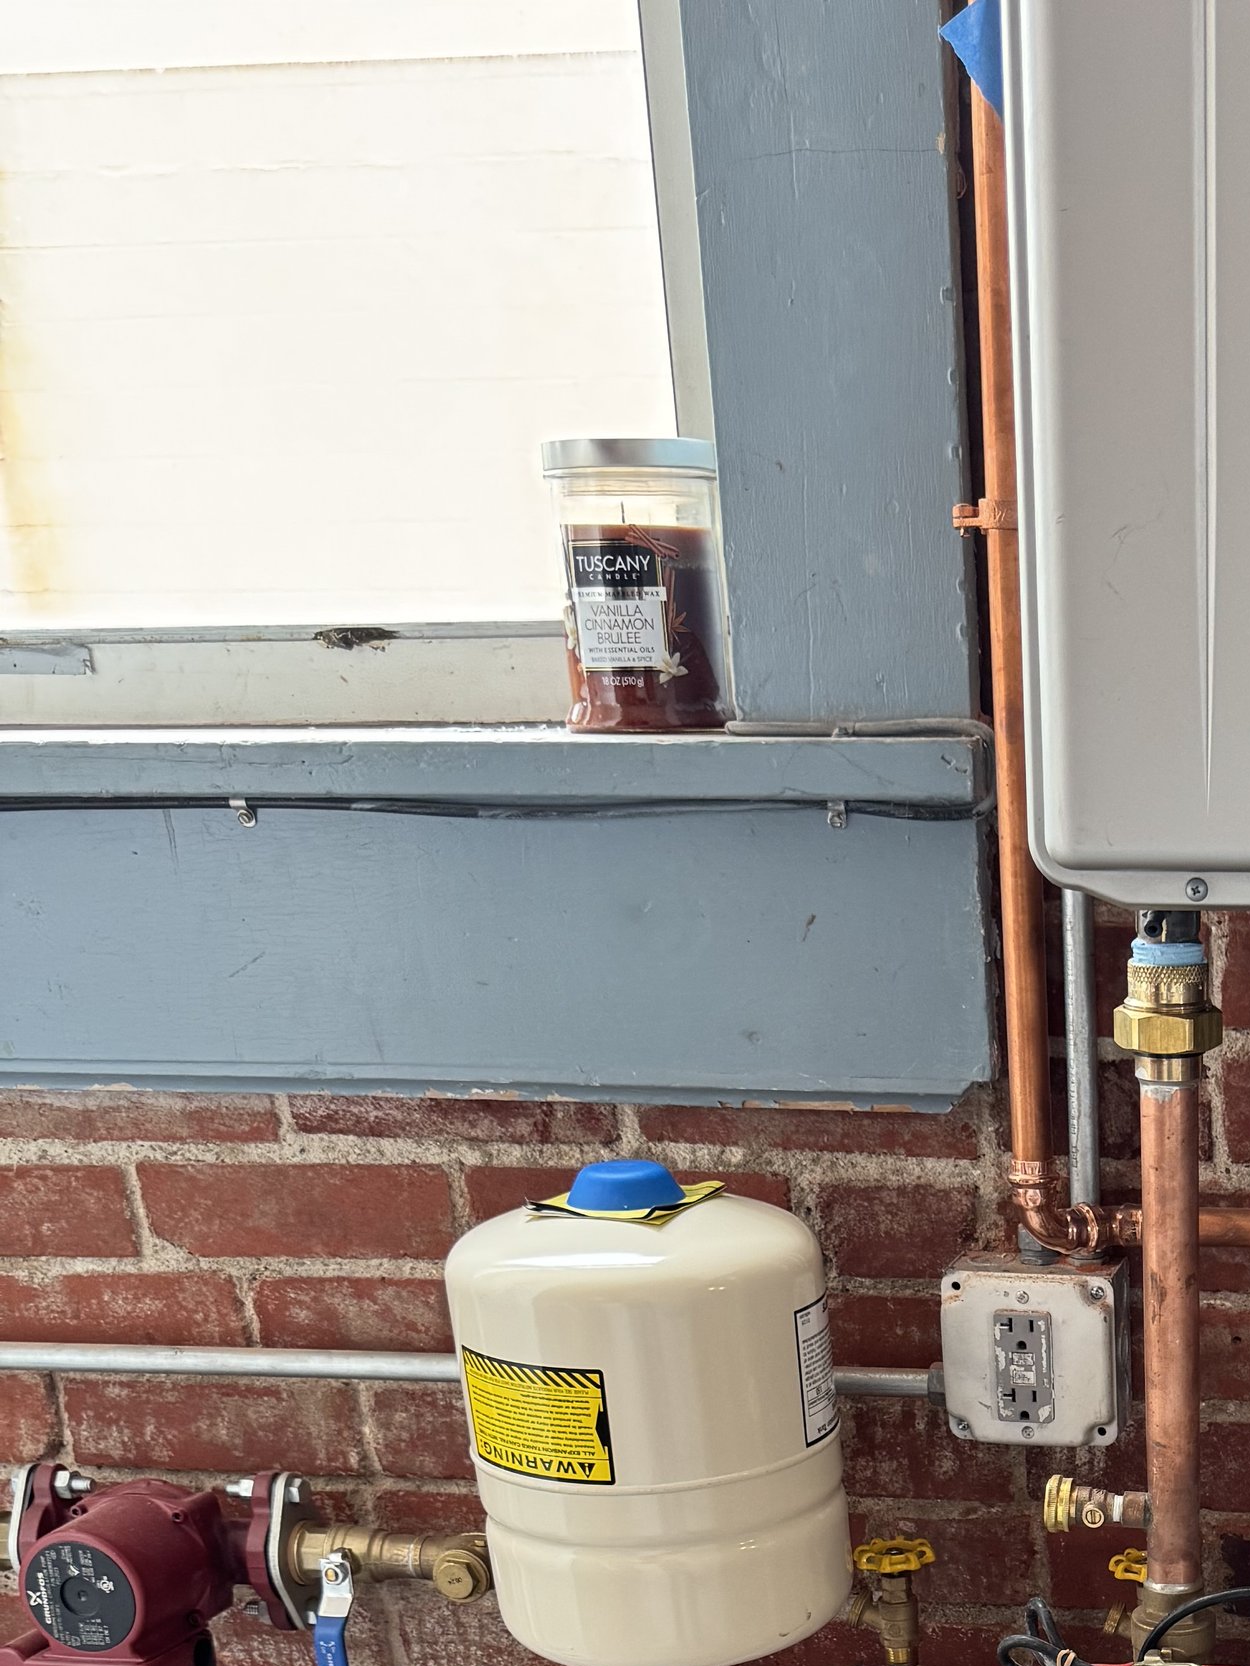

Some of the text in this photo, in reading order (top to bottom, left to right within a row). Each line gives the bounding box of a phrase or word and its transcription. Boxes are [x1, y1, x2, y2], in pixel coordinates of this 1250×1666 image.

[576, 555, 650, 572] TUSCANY
[590, 605, 643, 617] VANILLA
[585, 618, 655, 631] CINNAMON
[597, 632, 642, 644] BRULEE
[602, 676, 609, 685] 18
[610, 677, 621, 685] OZ
[621, 676, 636, 687] (510
[522, 1441, 541, 1451] TANKS
[542, 1445, 582, 1456] EXPANSION
[37, 1572, 52, 1625] GRUNDFOS
